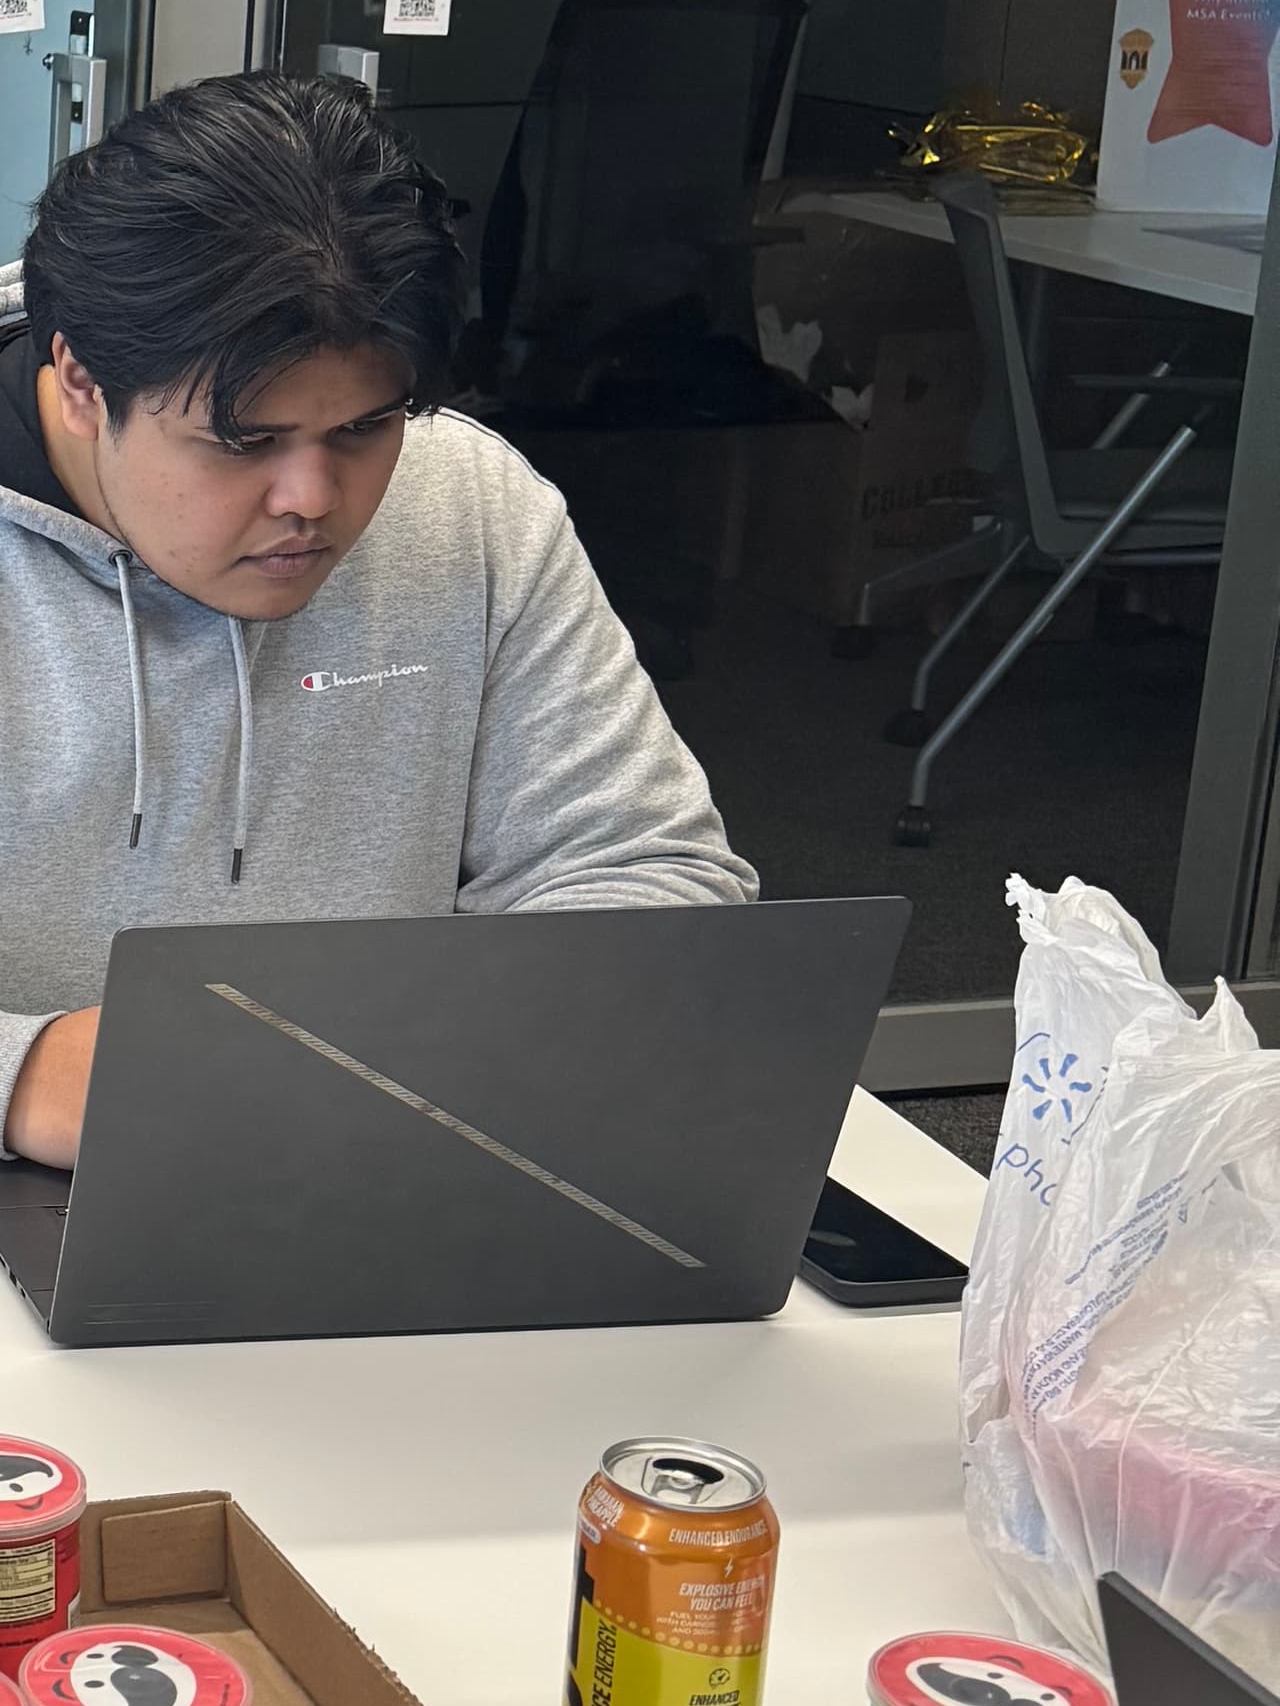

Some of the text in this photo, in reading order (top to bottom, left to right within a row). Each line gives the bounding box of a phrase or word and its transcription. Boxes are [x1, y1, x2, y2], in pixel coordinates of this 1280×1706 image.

[1186, 9, 1217, 20] MSA
[300, 662, 430, 692] Champion
[669, 1520, 769, 1547] ENHANCED ENDURANCE
[679, 1582, 734, 1597] EXPLOSIVE
[690, 1597, 710, 1611] YOU
[711, 1598, 733, 1609] CAN
[689, 1690, 739, 1706] ENHANCED
